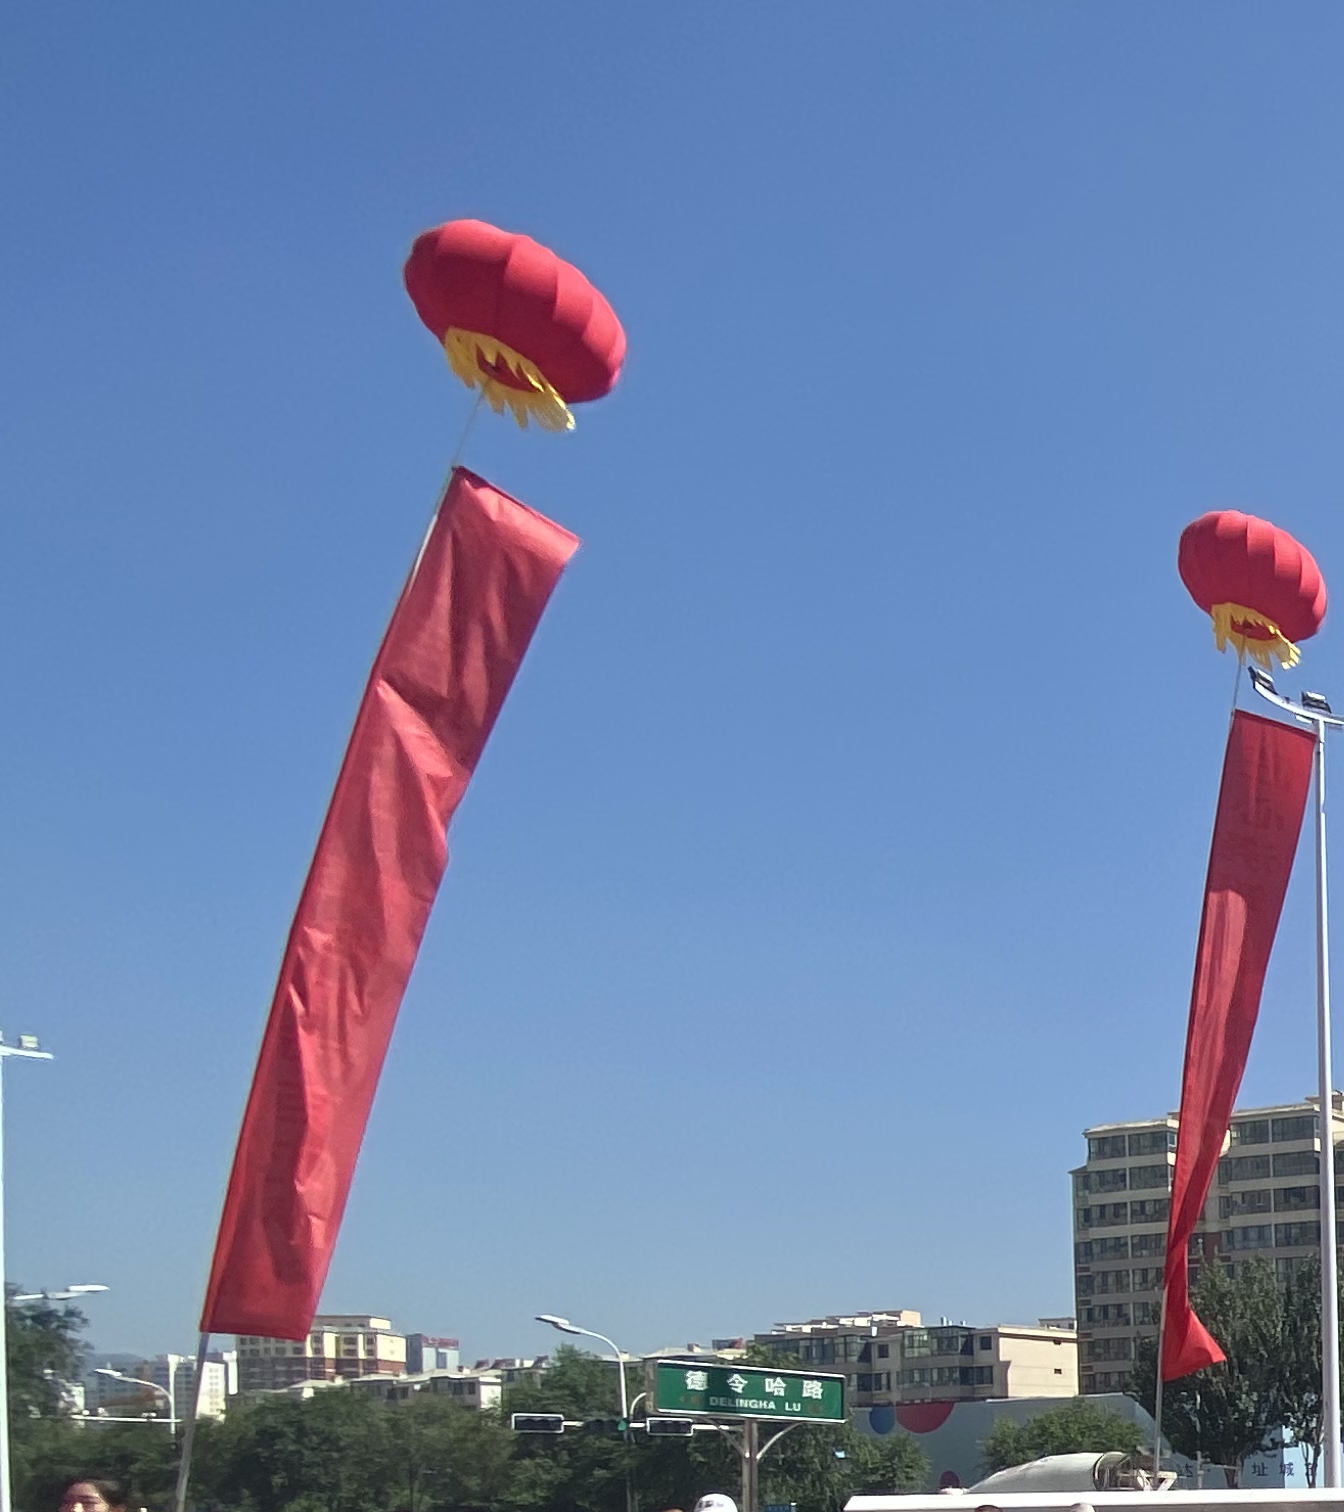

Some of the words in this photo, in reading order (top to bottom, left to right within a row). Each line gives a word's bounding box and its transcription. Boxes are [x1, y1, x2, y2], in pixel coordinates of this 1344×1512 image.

[685, 1370, 824, 1400] 德令哈路
[709, 1396, 776, 1410] DELINGHA
[785, 1402, 802, 1412] LU
